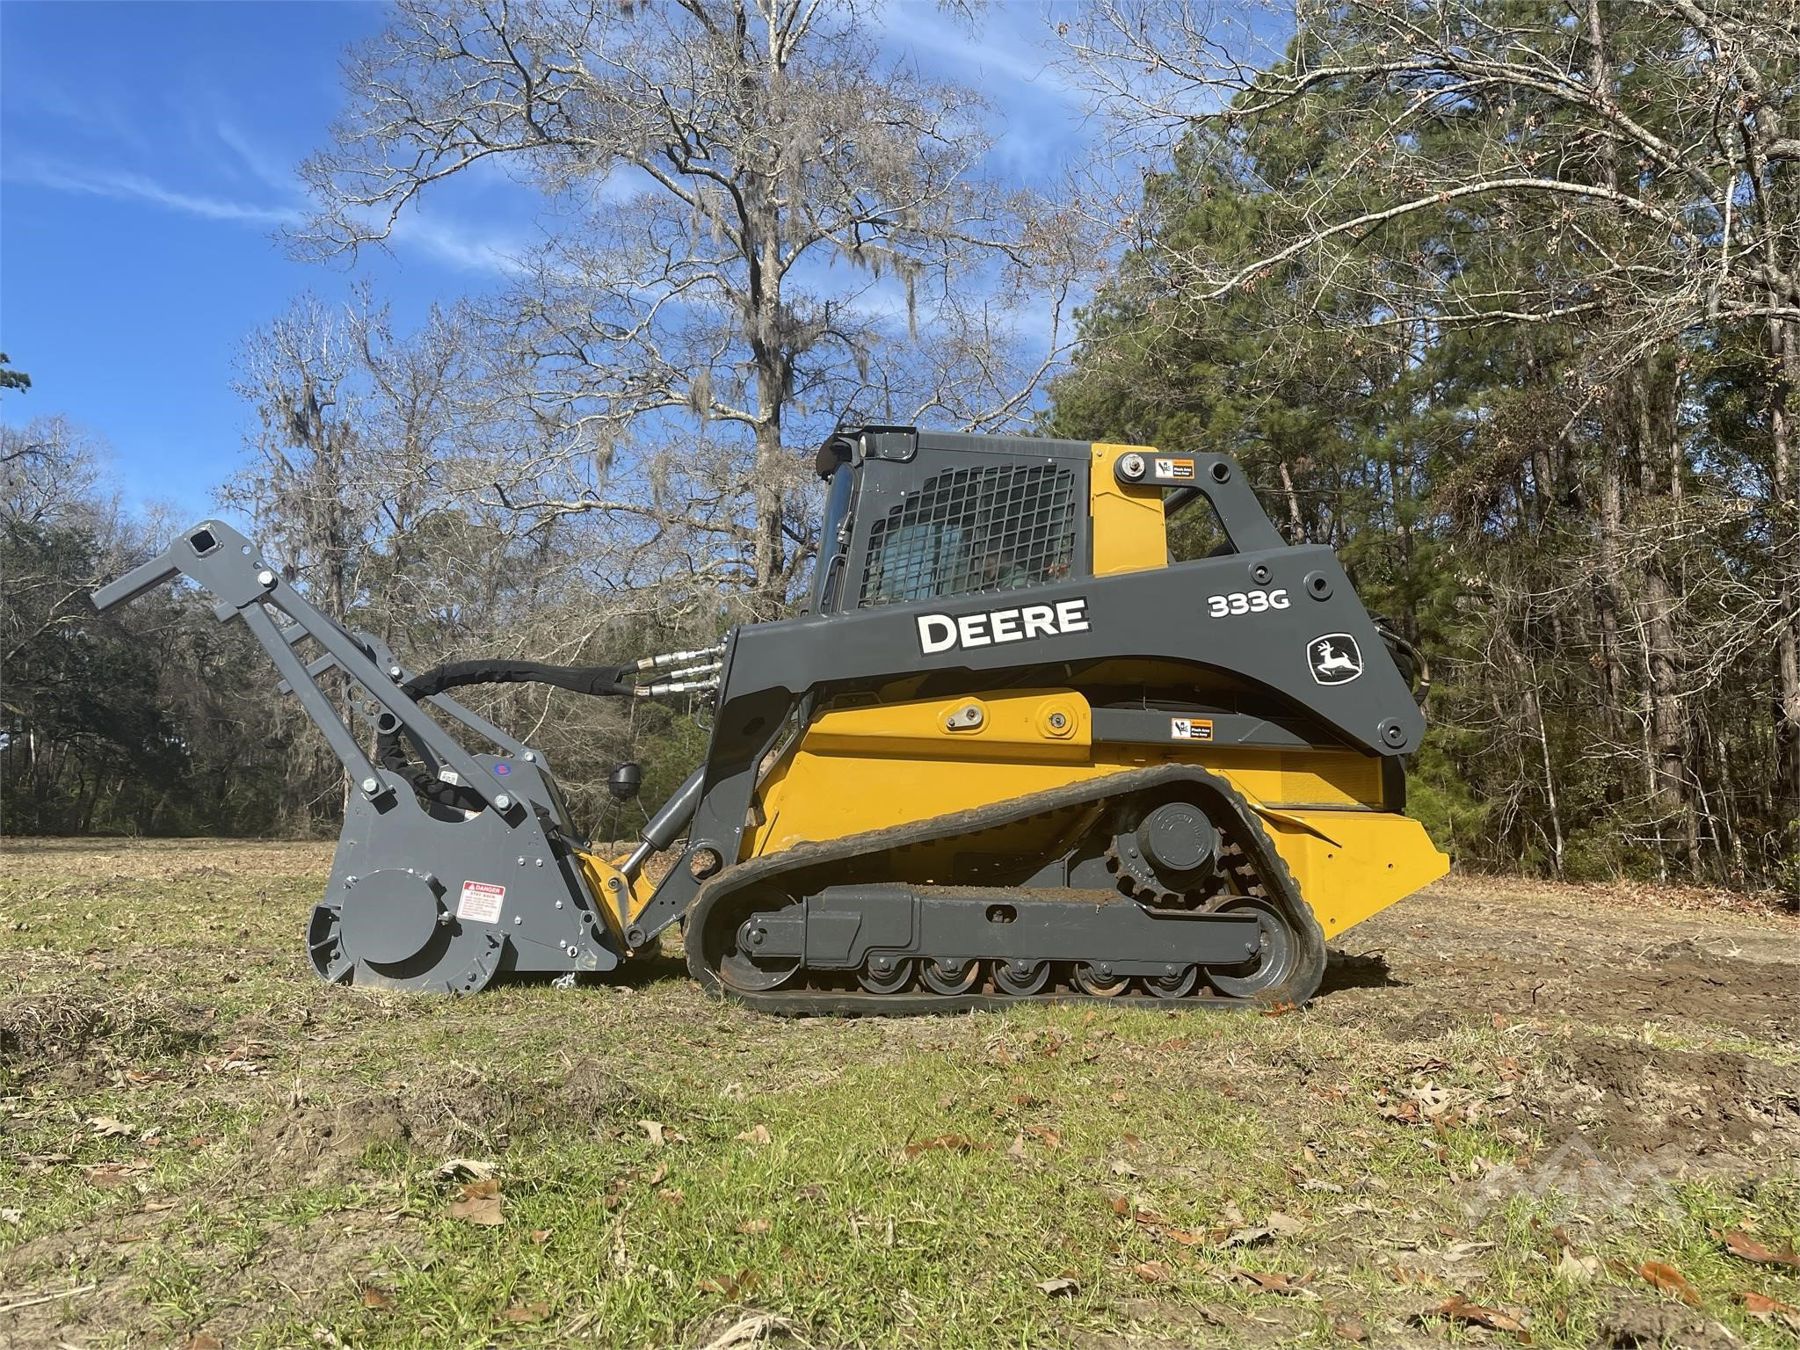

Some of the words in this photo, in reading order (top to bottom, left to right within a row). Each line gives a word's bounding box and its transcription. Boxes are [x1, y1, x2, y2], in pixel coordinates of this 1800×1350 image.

[1208, 589, 1290, 618] 333G
[917, 599, 1089, 654] DEERE
[475, 884, 501, 894] DANGER
